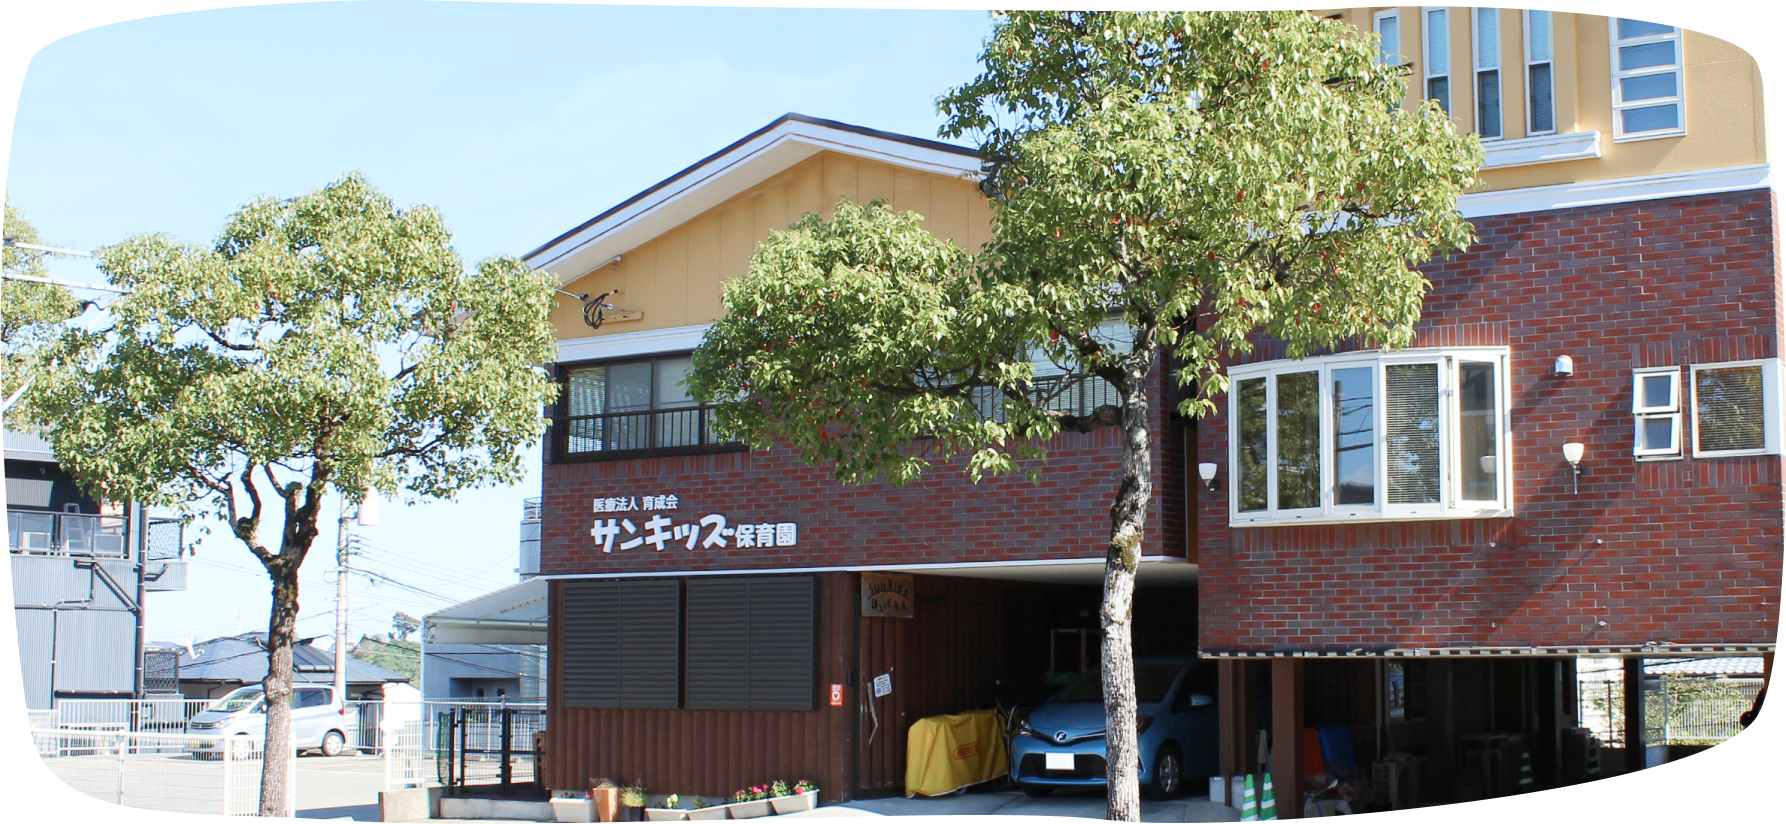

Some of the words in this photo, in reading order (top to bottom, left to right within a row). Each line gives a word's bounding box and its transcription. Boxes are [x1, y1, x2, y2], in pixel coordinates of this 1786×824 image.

[593, 496, 639, 513] 医療法人
[642, 494, 678, 511] 育成会
